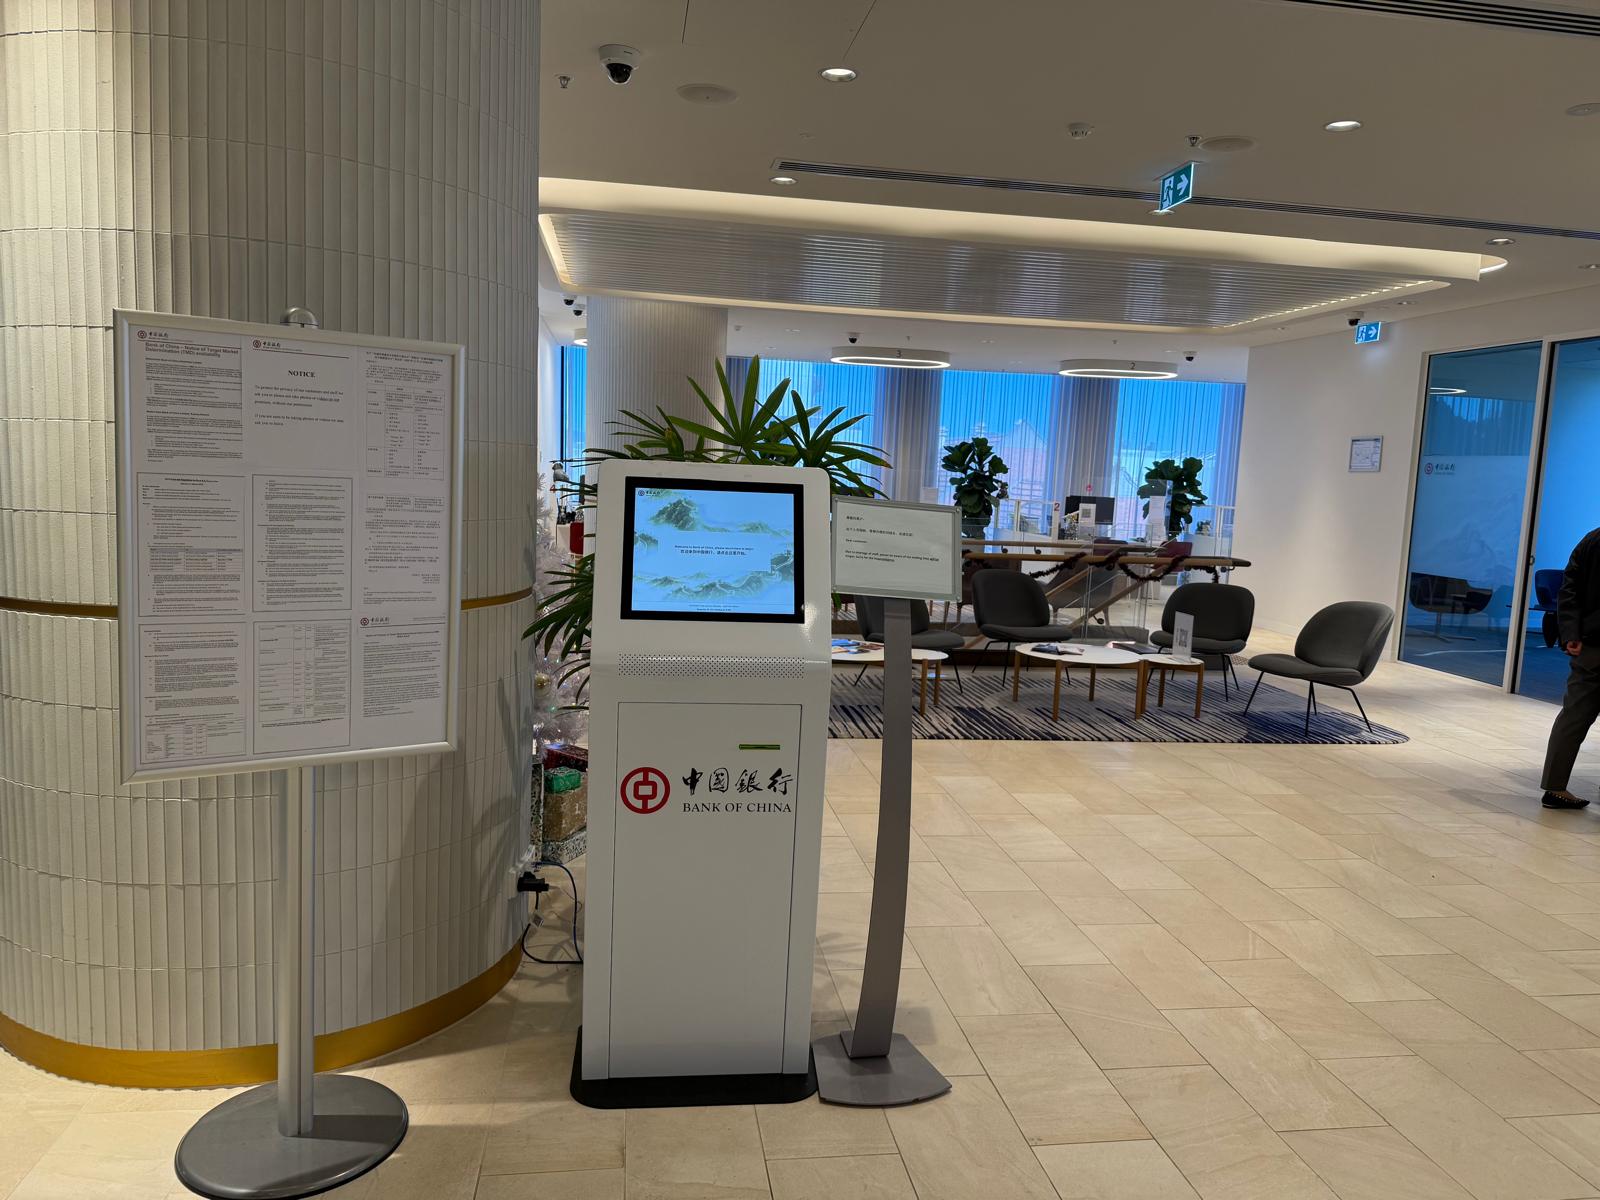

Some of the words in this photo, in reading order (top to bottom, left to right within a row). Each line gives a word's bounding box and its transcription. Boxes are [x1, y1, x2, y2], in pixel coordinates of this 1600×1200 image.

[896, 350, 902, 358] 3
[1129, 362, 1136, 370] 2
[288, 370, 315, 378] NOTICE
[1054, 503, 1060, 512] 2
[683, 803, 721, 812] BANK
[725, 803, 743, 812] OF
[747, 803, 791, 812] CHINA
